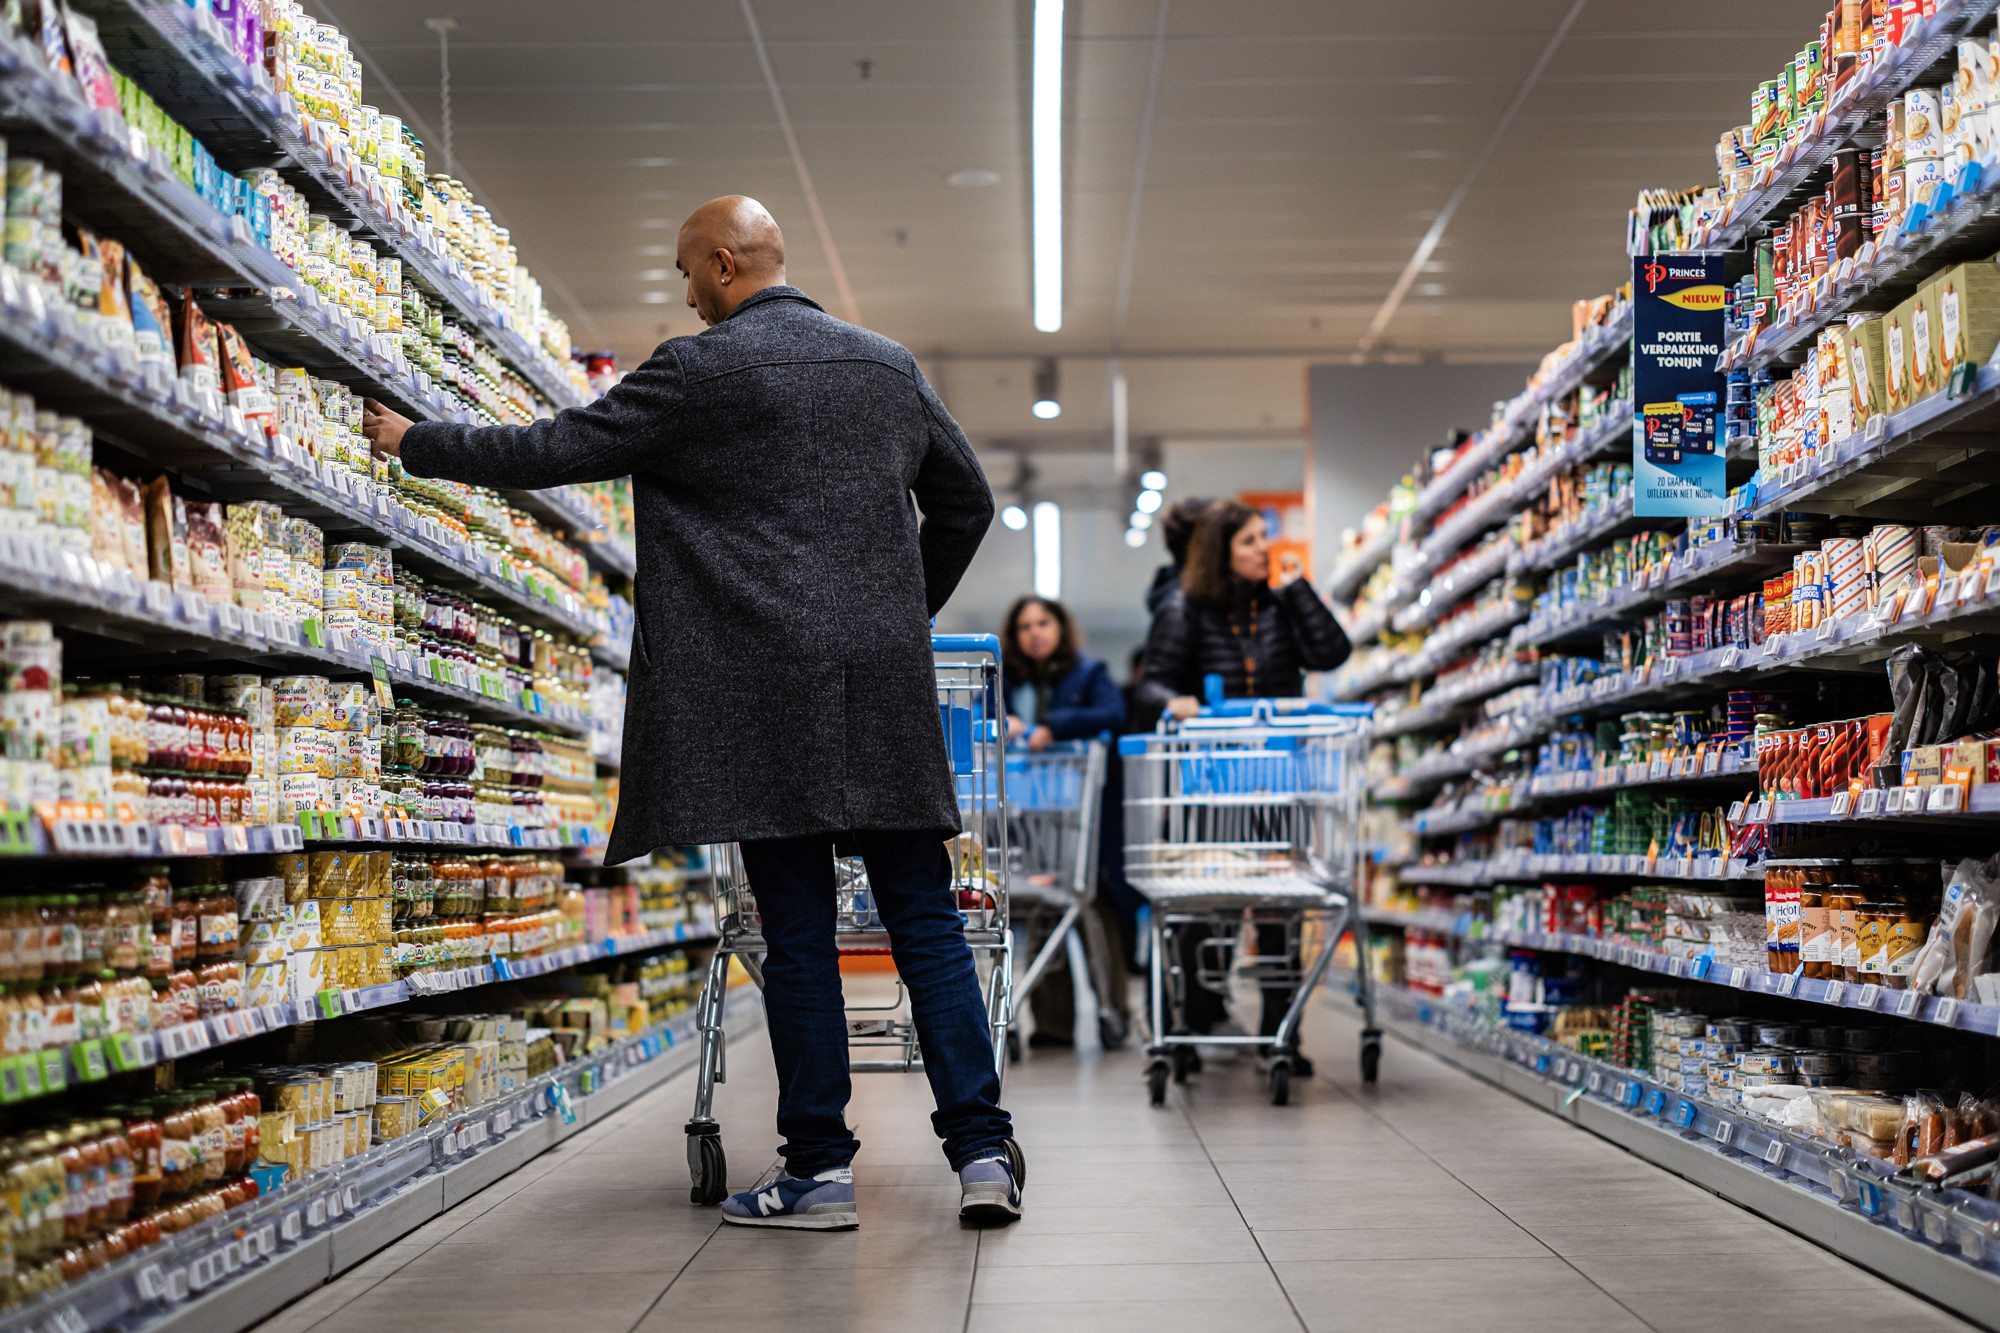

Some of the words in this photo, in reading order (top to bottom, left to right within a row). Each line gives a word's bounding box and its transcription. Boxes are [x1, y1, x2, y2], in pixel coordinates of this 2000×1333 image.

[317, 32, 339, 45] Bondu
[1907, 105, 1930, 116] KALFS
[1906, 132, 1936, 150] AGOUT
[1669, 268, 1706, 277] PRINCES
[1682, 295, 1721, 303] NIEUW
[1658, 332, 1701, 342] PORTIE
[1641, 344, 1718, 355] VERPAKKING
[1657, 357, 1702, 369] TONIJN
[1658, 477, 1666, 486] 20
[1668, 477, 1683, 486] GRAM
[1647, 489, 1678, 498] UITLEKKEN
[1680, 489, 1693, 498] NIET
[343, 549, 365, 557] Bonduell
[273, 684, 308, 695] Bonduelle
[294, 733, 316, 744] Bondu
[348, 736, 363, 747] Bond
[758, 1186, 784, 1216] N
